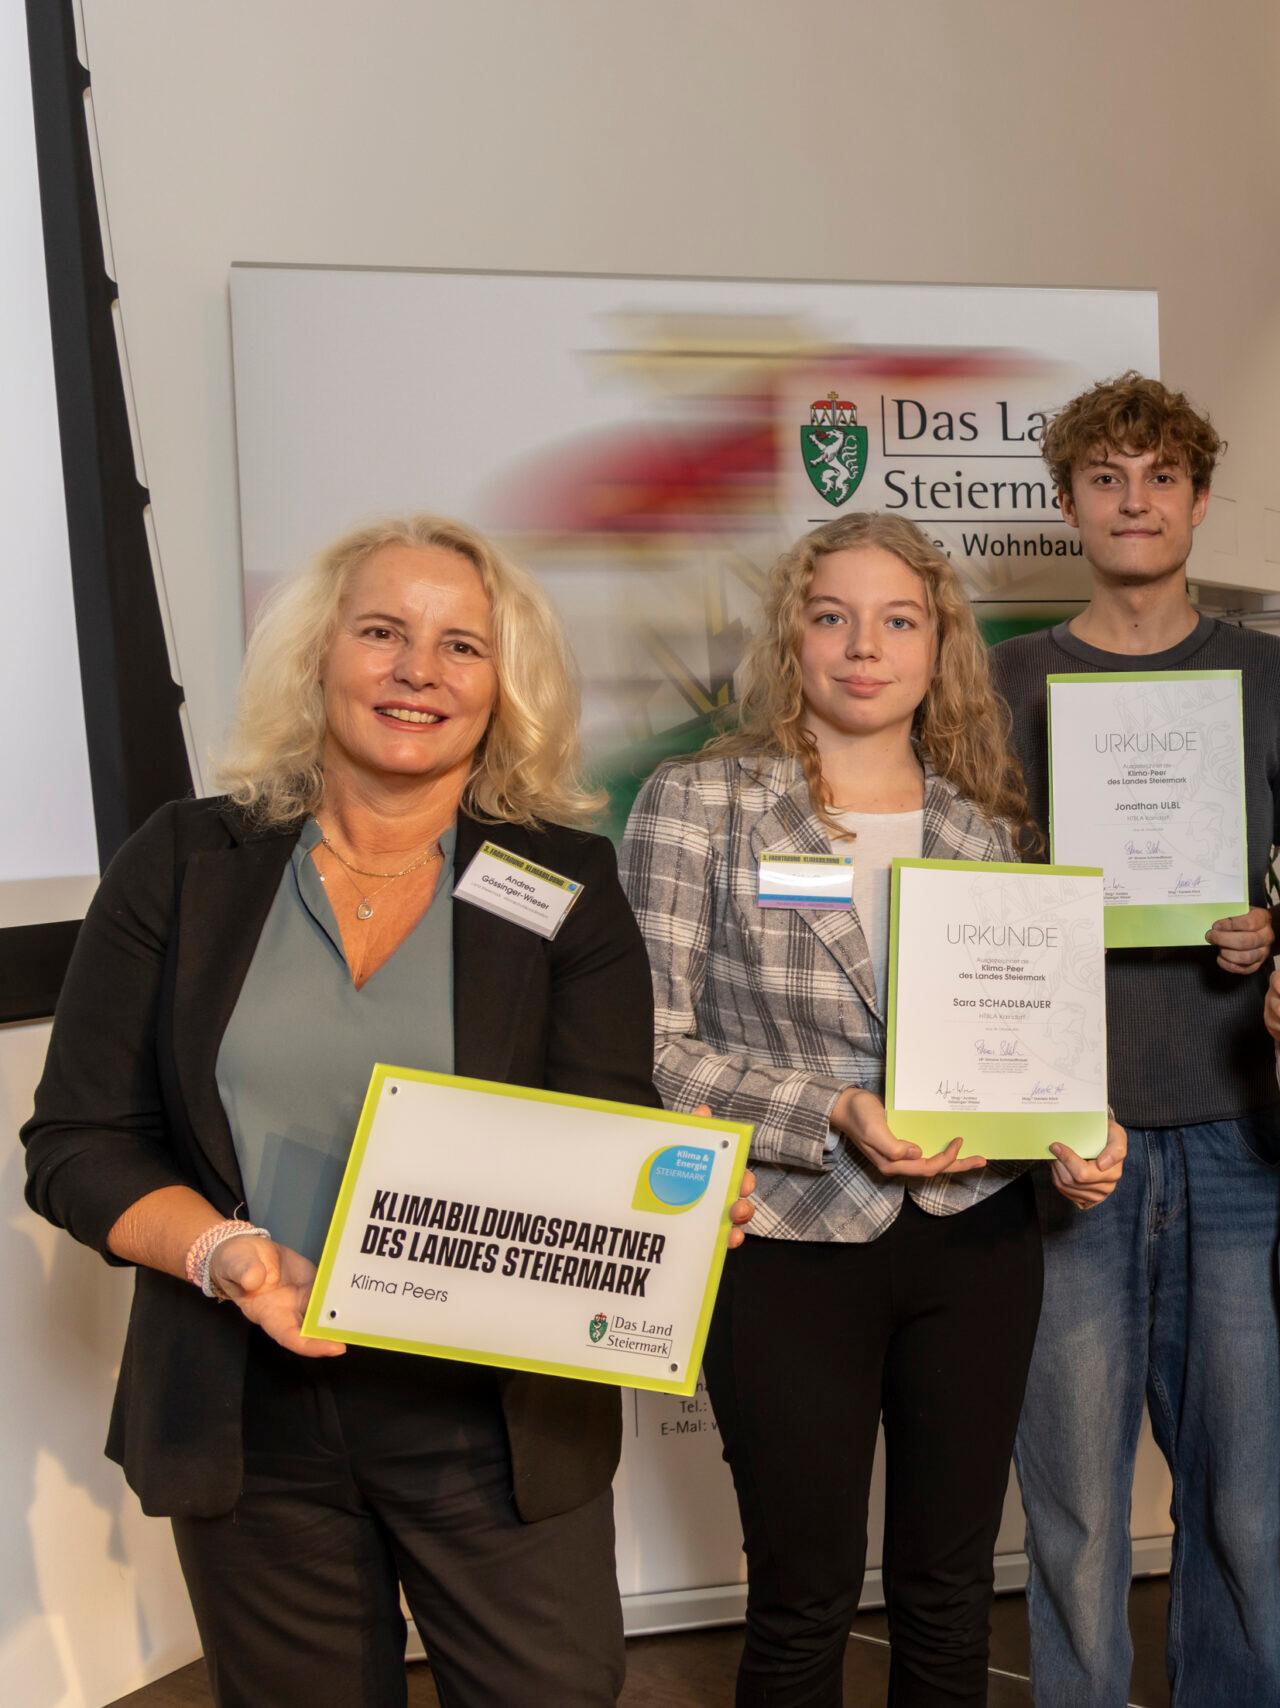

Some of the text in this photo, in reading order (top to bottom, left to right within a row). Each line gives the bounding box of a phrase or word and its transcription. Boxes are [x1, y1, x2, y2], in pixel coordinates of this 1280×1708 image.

[891, 398, 978, 441] Das
[1094, 731, 1197, 754] URKUNDE
[1107, 776, 1187, 785] des Landes Steiermark
[1127, 769, 1167, 777] Klima-Peer
[1114, 801, 1182, 812] Jonathan ULBL
[505, 875, 536, 893] Andrea
[481, 875, 550, 910] Gössinger-Wieser
[947, 923, 1058, 948] URKUNDE
[958, 972, 1046, 981] des Landes Steiermark
[981, 965, 1025, 973] Klima-Peer
[953, 998, 1051, 1009] Sara SCHADLBAUER
[677, 1150, 702, 1160] Klima
[676, 1159, 708, 1172] Energie
[656, 1167, 705, 1181] STEIERMARK
[369, 1189, 666, 1264] KLIMABILDUNGSPARTNER
[360, 1224, 651, 1297] DES LANDES STEIERMARK
[351, 1273, 449, 1302] Klima Peers
[615, 1316, 673, 1336] Das Land
[607, 1335, 668, 1355] Steiermark
[680, 1400, 708, 1413] Tel.:
